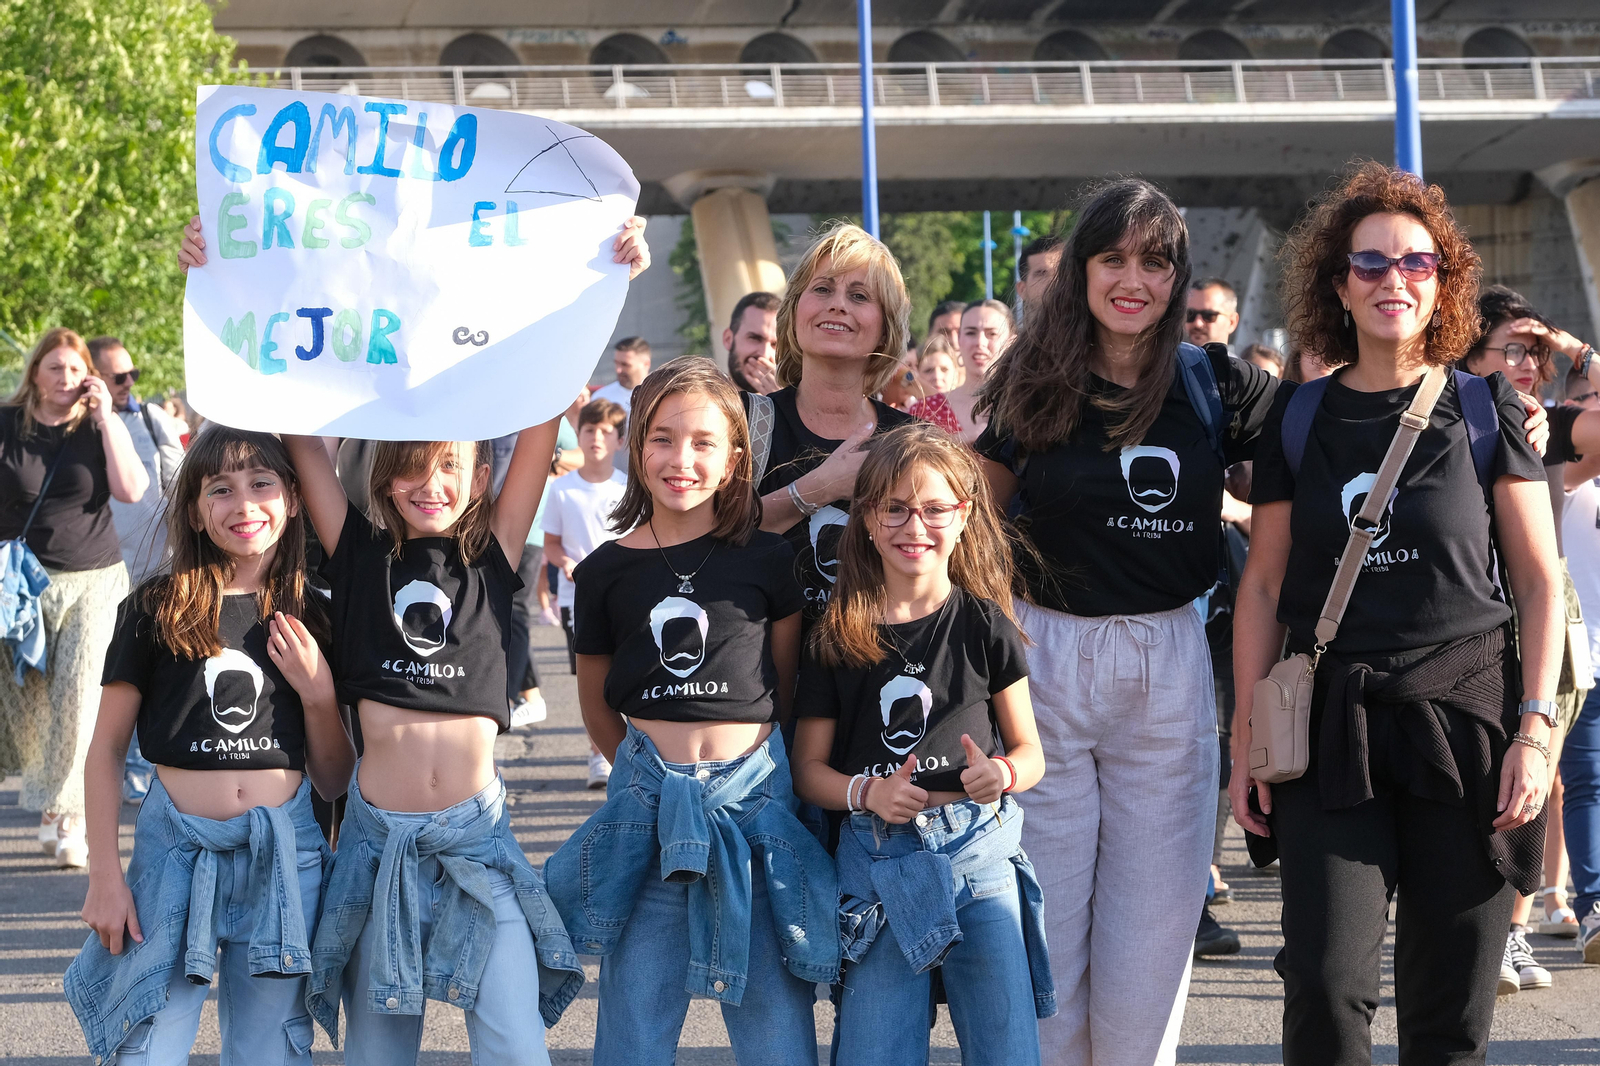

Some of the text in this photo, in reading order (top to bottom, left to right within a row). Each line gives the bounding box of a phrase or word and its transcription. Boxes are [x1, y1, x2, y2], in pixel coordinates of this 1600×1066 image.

[209, 101, 478, 183] CAMILO
[217, 187, 529, 259] ERES EL
[221, 307, 401, 375] MEJOR
[1117, 515, 1185, 533] CAMILO
[1143, 531, 1162, 539] TRIBU
[1362, 548, 1409, 567] MILO
[392, 659, 455, 679] CAMILO
[651, 681, 719, 699] CAMILO
[200, 736, 272, 753] CAMILO
[218, 752, 251, 761] LA TRIBU
